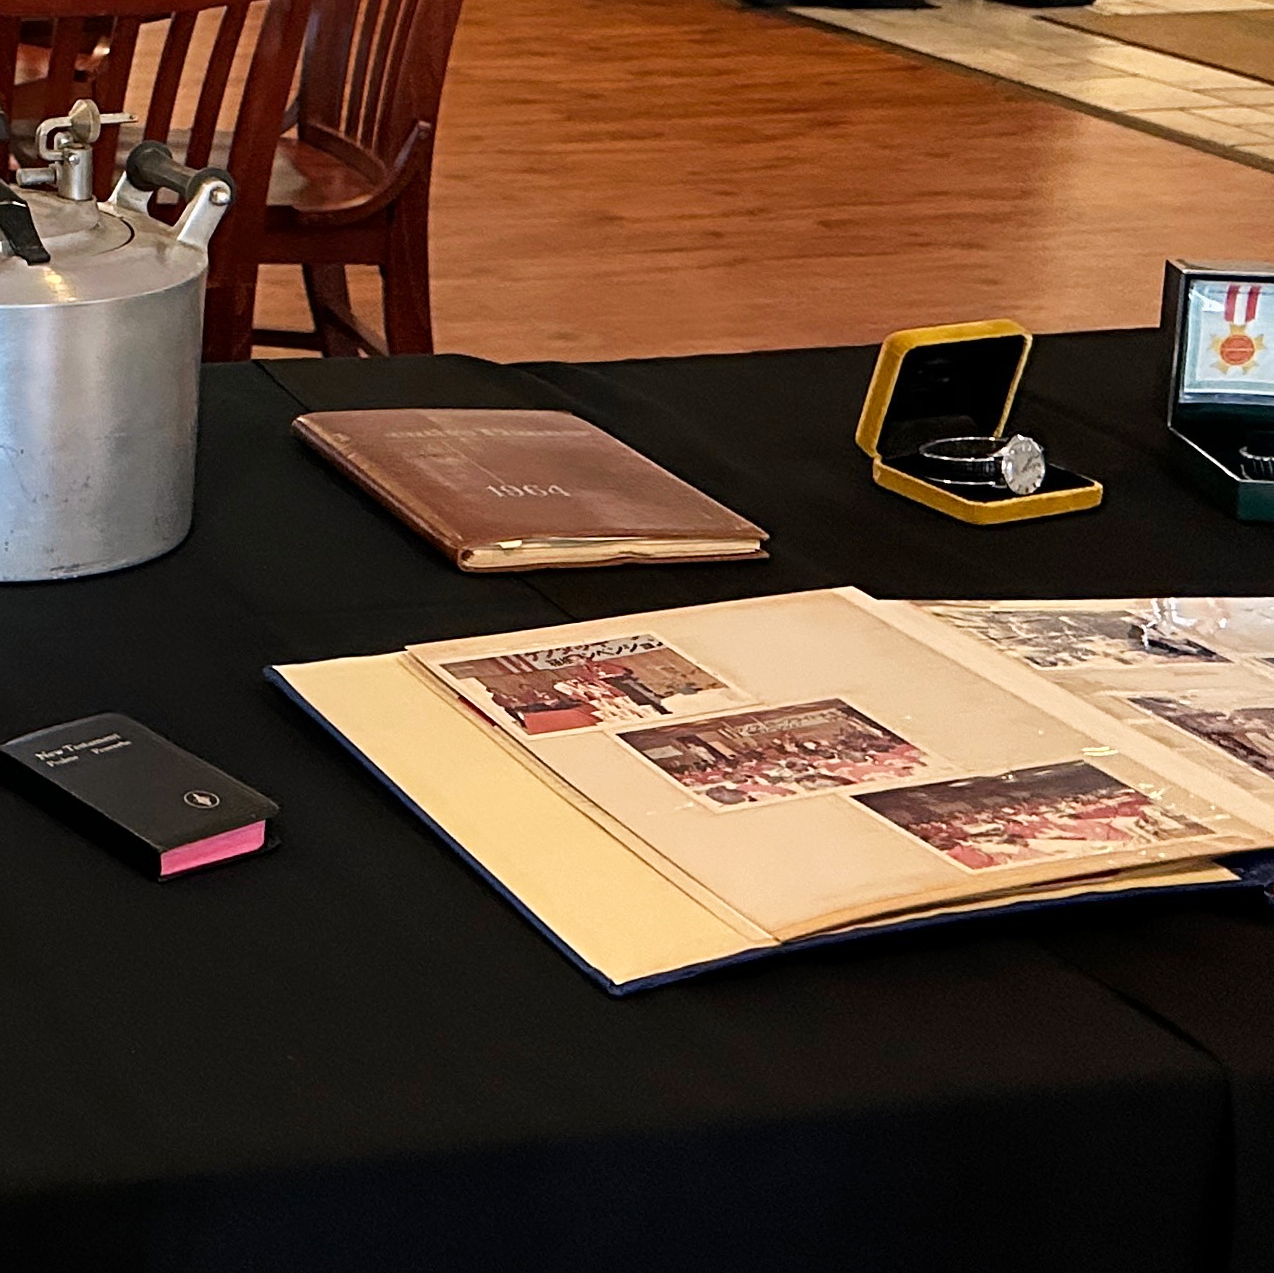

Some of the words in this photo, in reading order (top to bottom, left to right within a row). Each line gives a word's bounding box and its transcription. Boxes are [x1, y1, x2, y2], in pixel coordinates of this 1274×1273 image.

[486, 484, 571, 498] 1964
[35, 749, 63, 761] New
[62, 733, 121, 752] Testament
